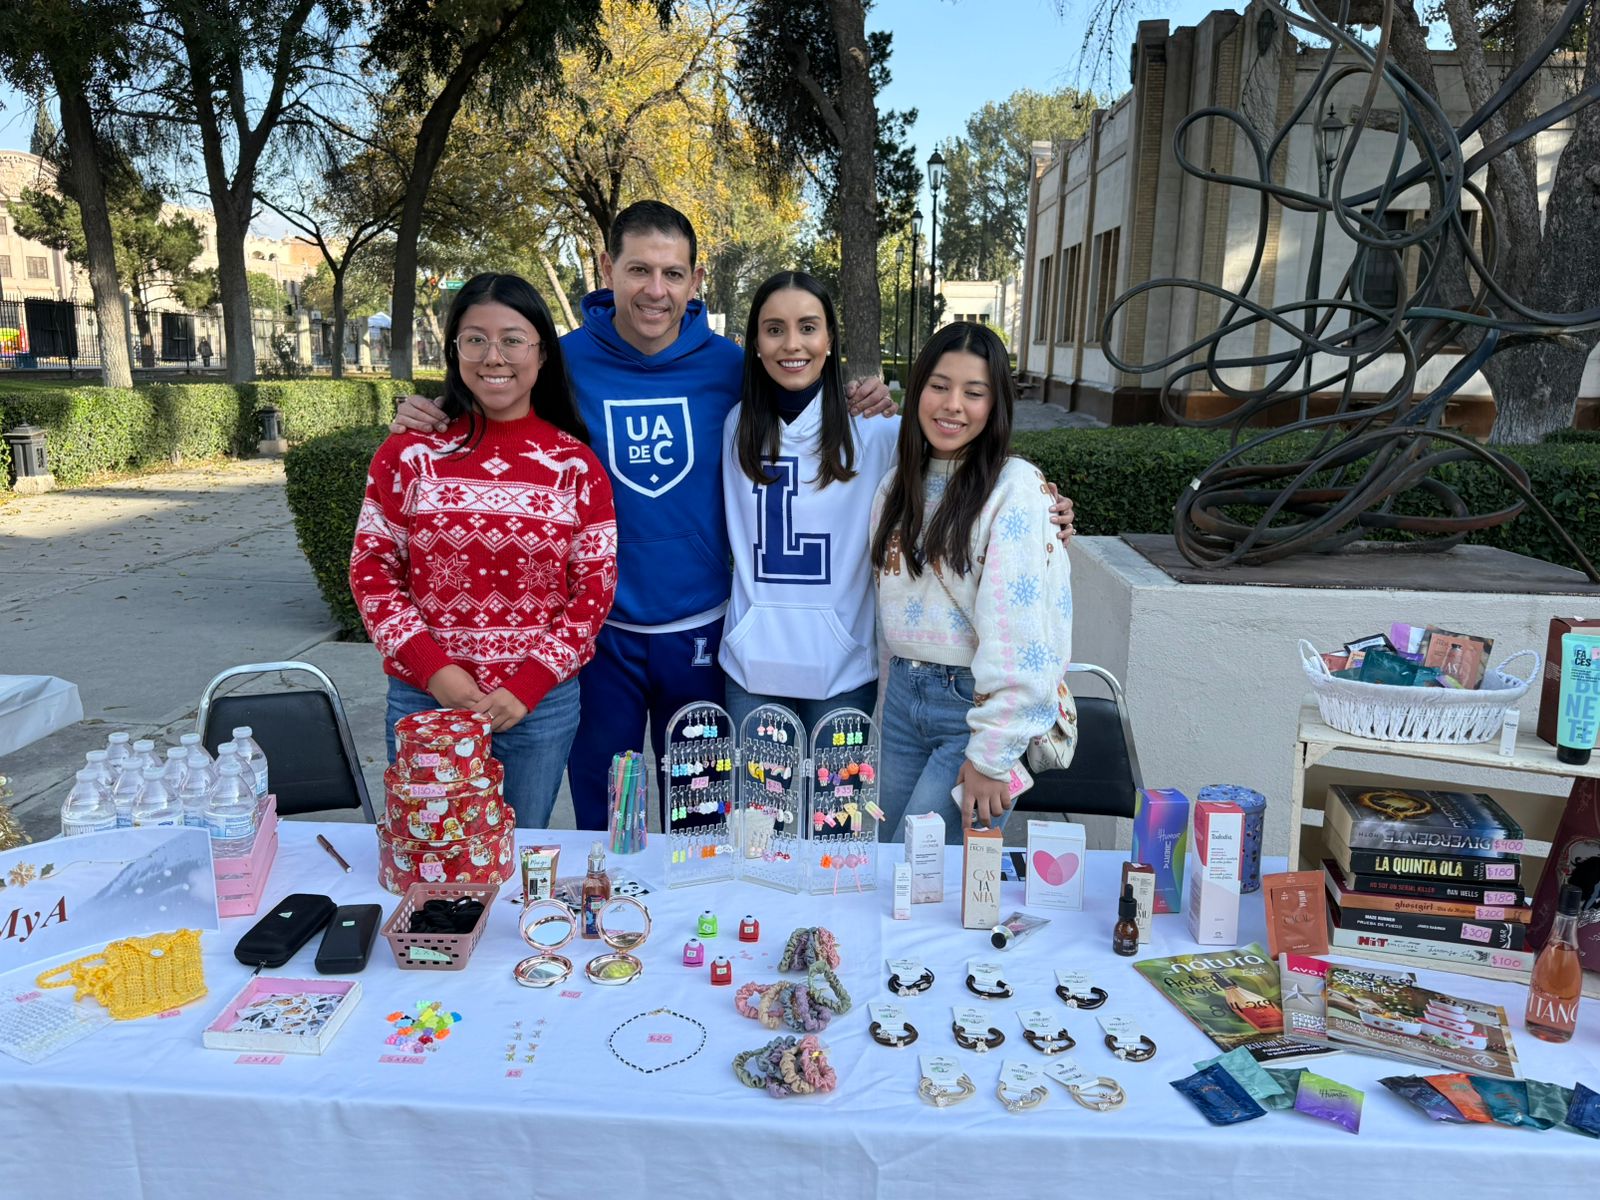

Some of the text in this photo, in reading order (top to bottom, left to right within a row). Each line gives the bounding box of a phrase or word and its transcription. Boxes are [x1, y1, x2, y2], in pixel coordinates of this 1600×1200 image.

[626, 415, 674, 441] UA
[629, 440, 674, 466] DE C
[752, 455, 831, 585] L
[691, 637, 712, 666] L
[1565, 693, 1597, 719] NE
[1568, 718, 1595, 743] TE
[420, 755, 439, 765] $50
[1384, 829, 1490, 850] DIVERGENTE
[1493, 840, 1523, 851] $400
[421, 864, 442, 877] $70
[1375, 856, 1463, 877] LA QUINTA OLA
[1487, 867, 1514, 878] $180
[1446, 888, 1479, 898] DAN WELLS
[1486, 893, 1514, 903] $180
[1394, 901, 1433, 913] ghostgirl
[1477, 908, 1504, 919] $200
[1462, 925, 1490, 940] $300
[1170, 954, 1265, 974] natura
[1492, 955, 1521, 968] $100
[1291, 966, 1327, 977] AVON
